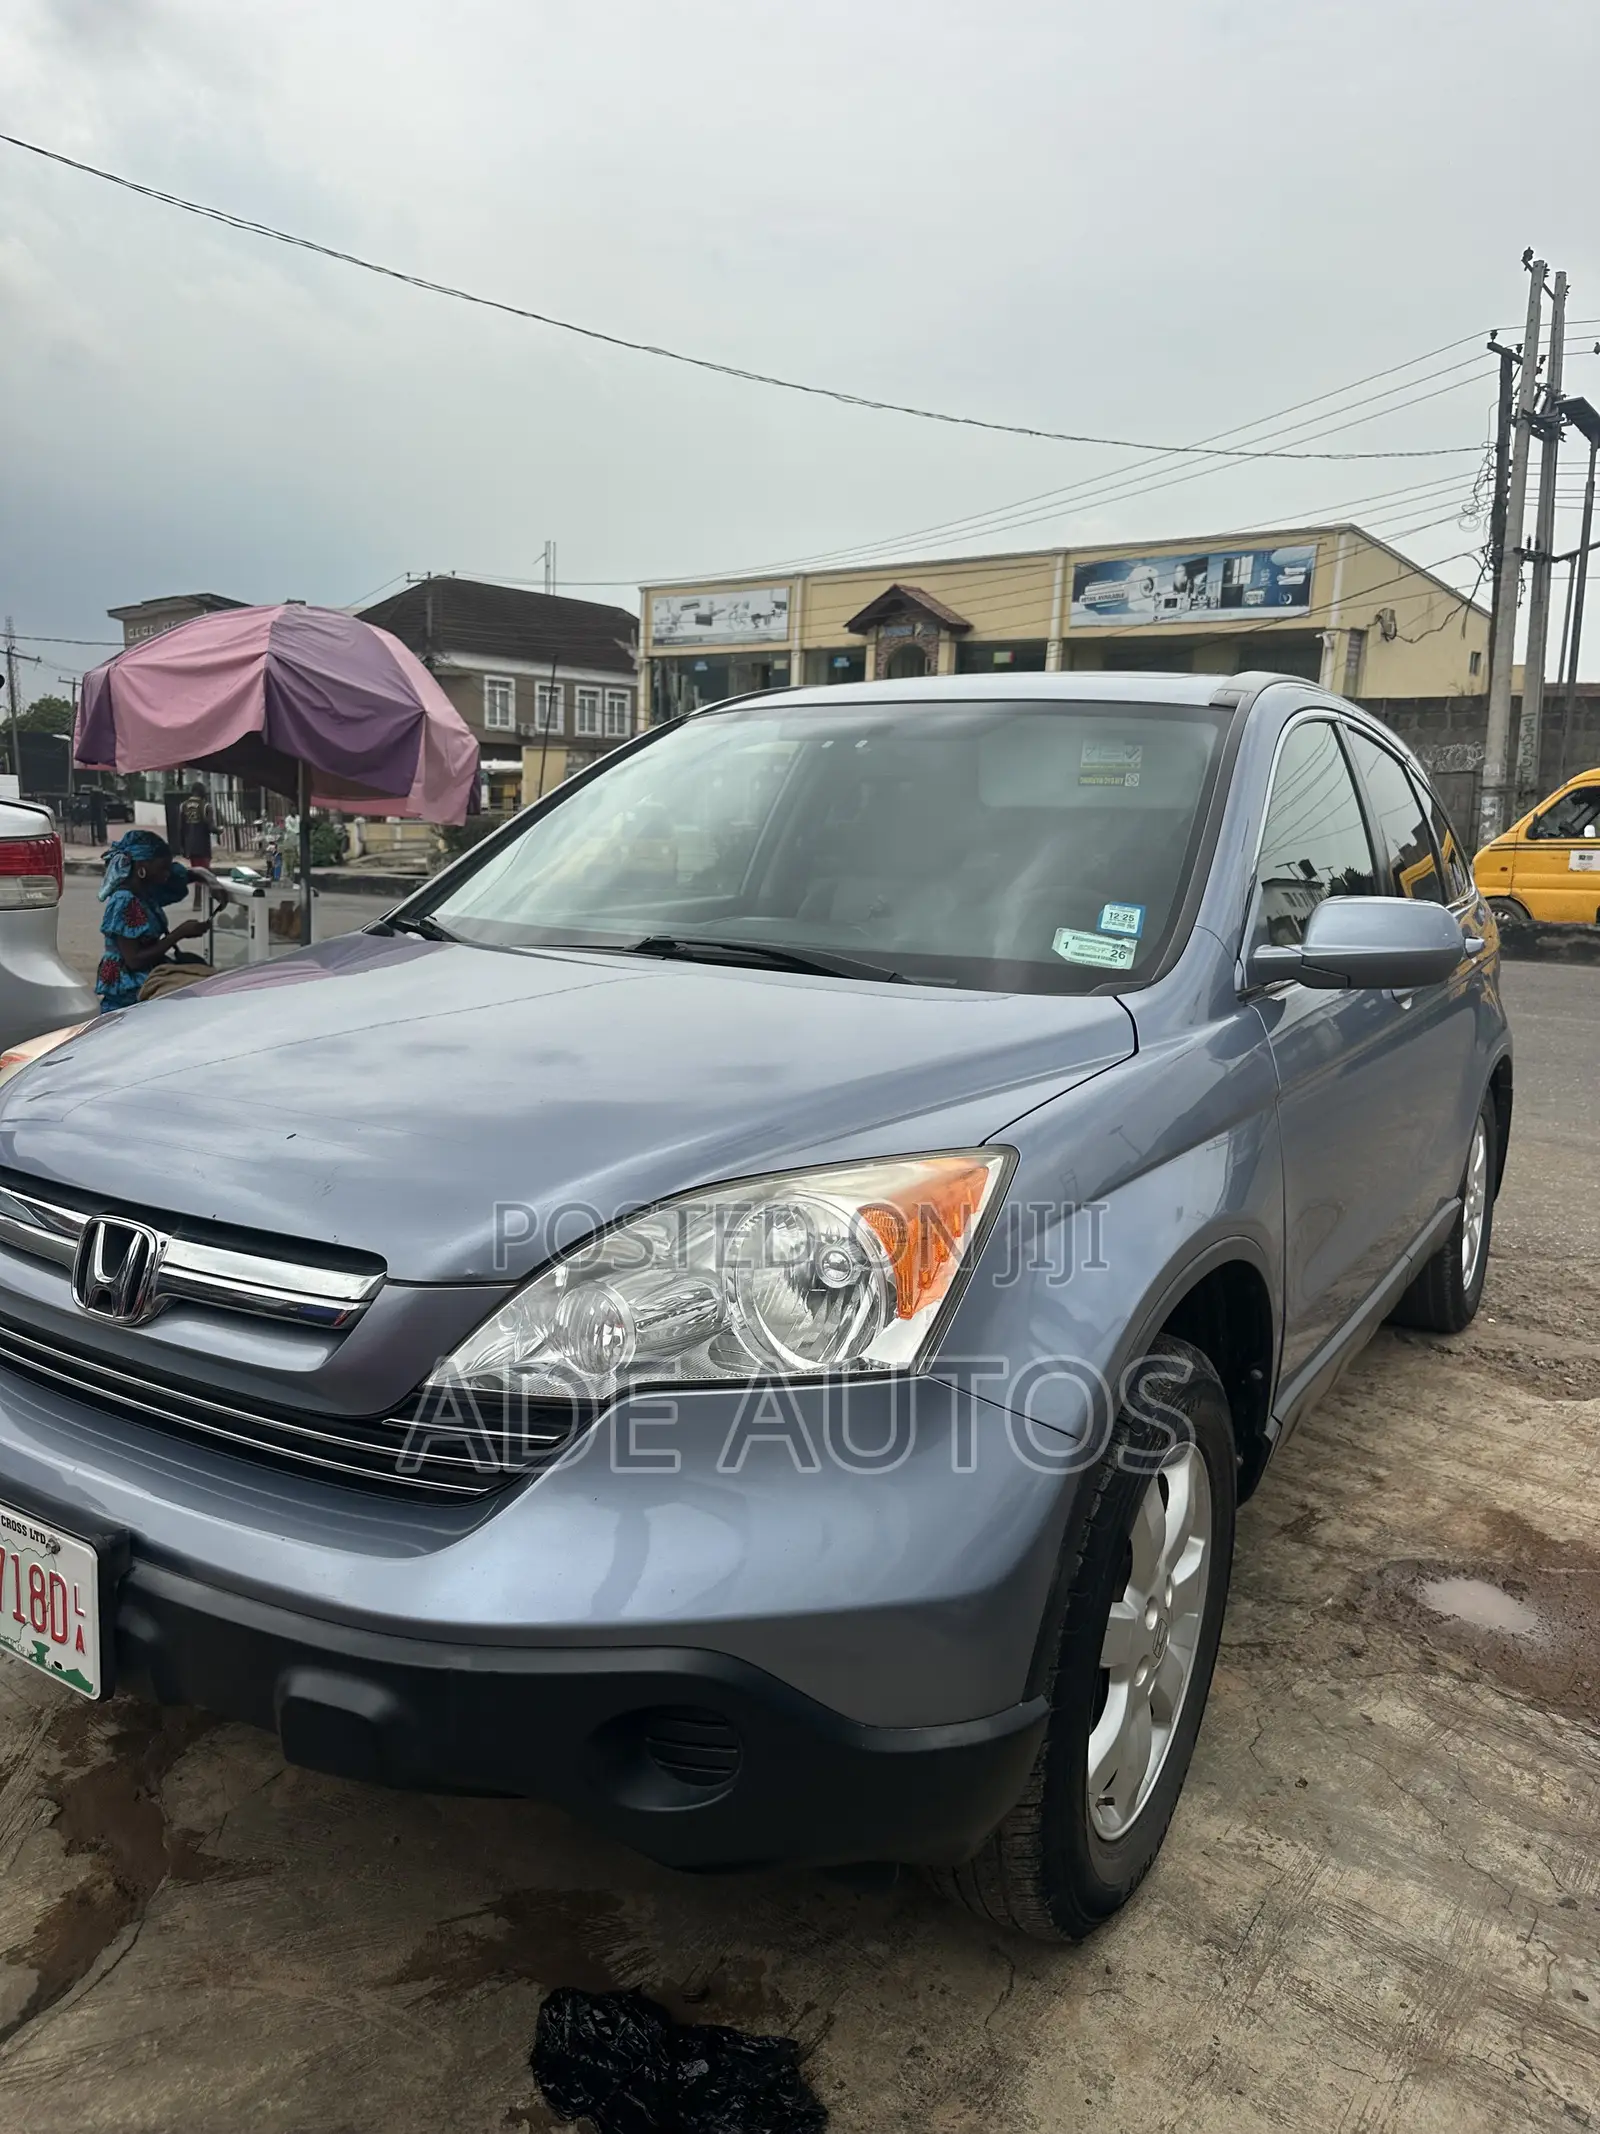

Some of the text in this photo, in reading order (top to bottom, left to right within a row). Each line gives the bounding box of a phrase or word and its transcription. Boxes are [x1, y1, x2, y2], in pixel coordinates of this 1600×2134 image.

[1109, 912, 1135, 922] 12 25
[1063, 941, 1069, 950] 1
[1110, 949, 1126, 960] 26
[1, 1515, 46, 1545] CROSS LTD
